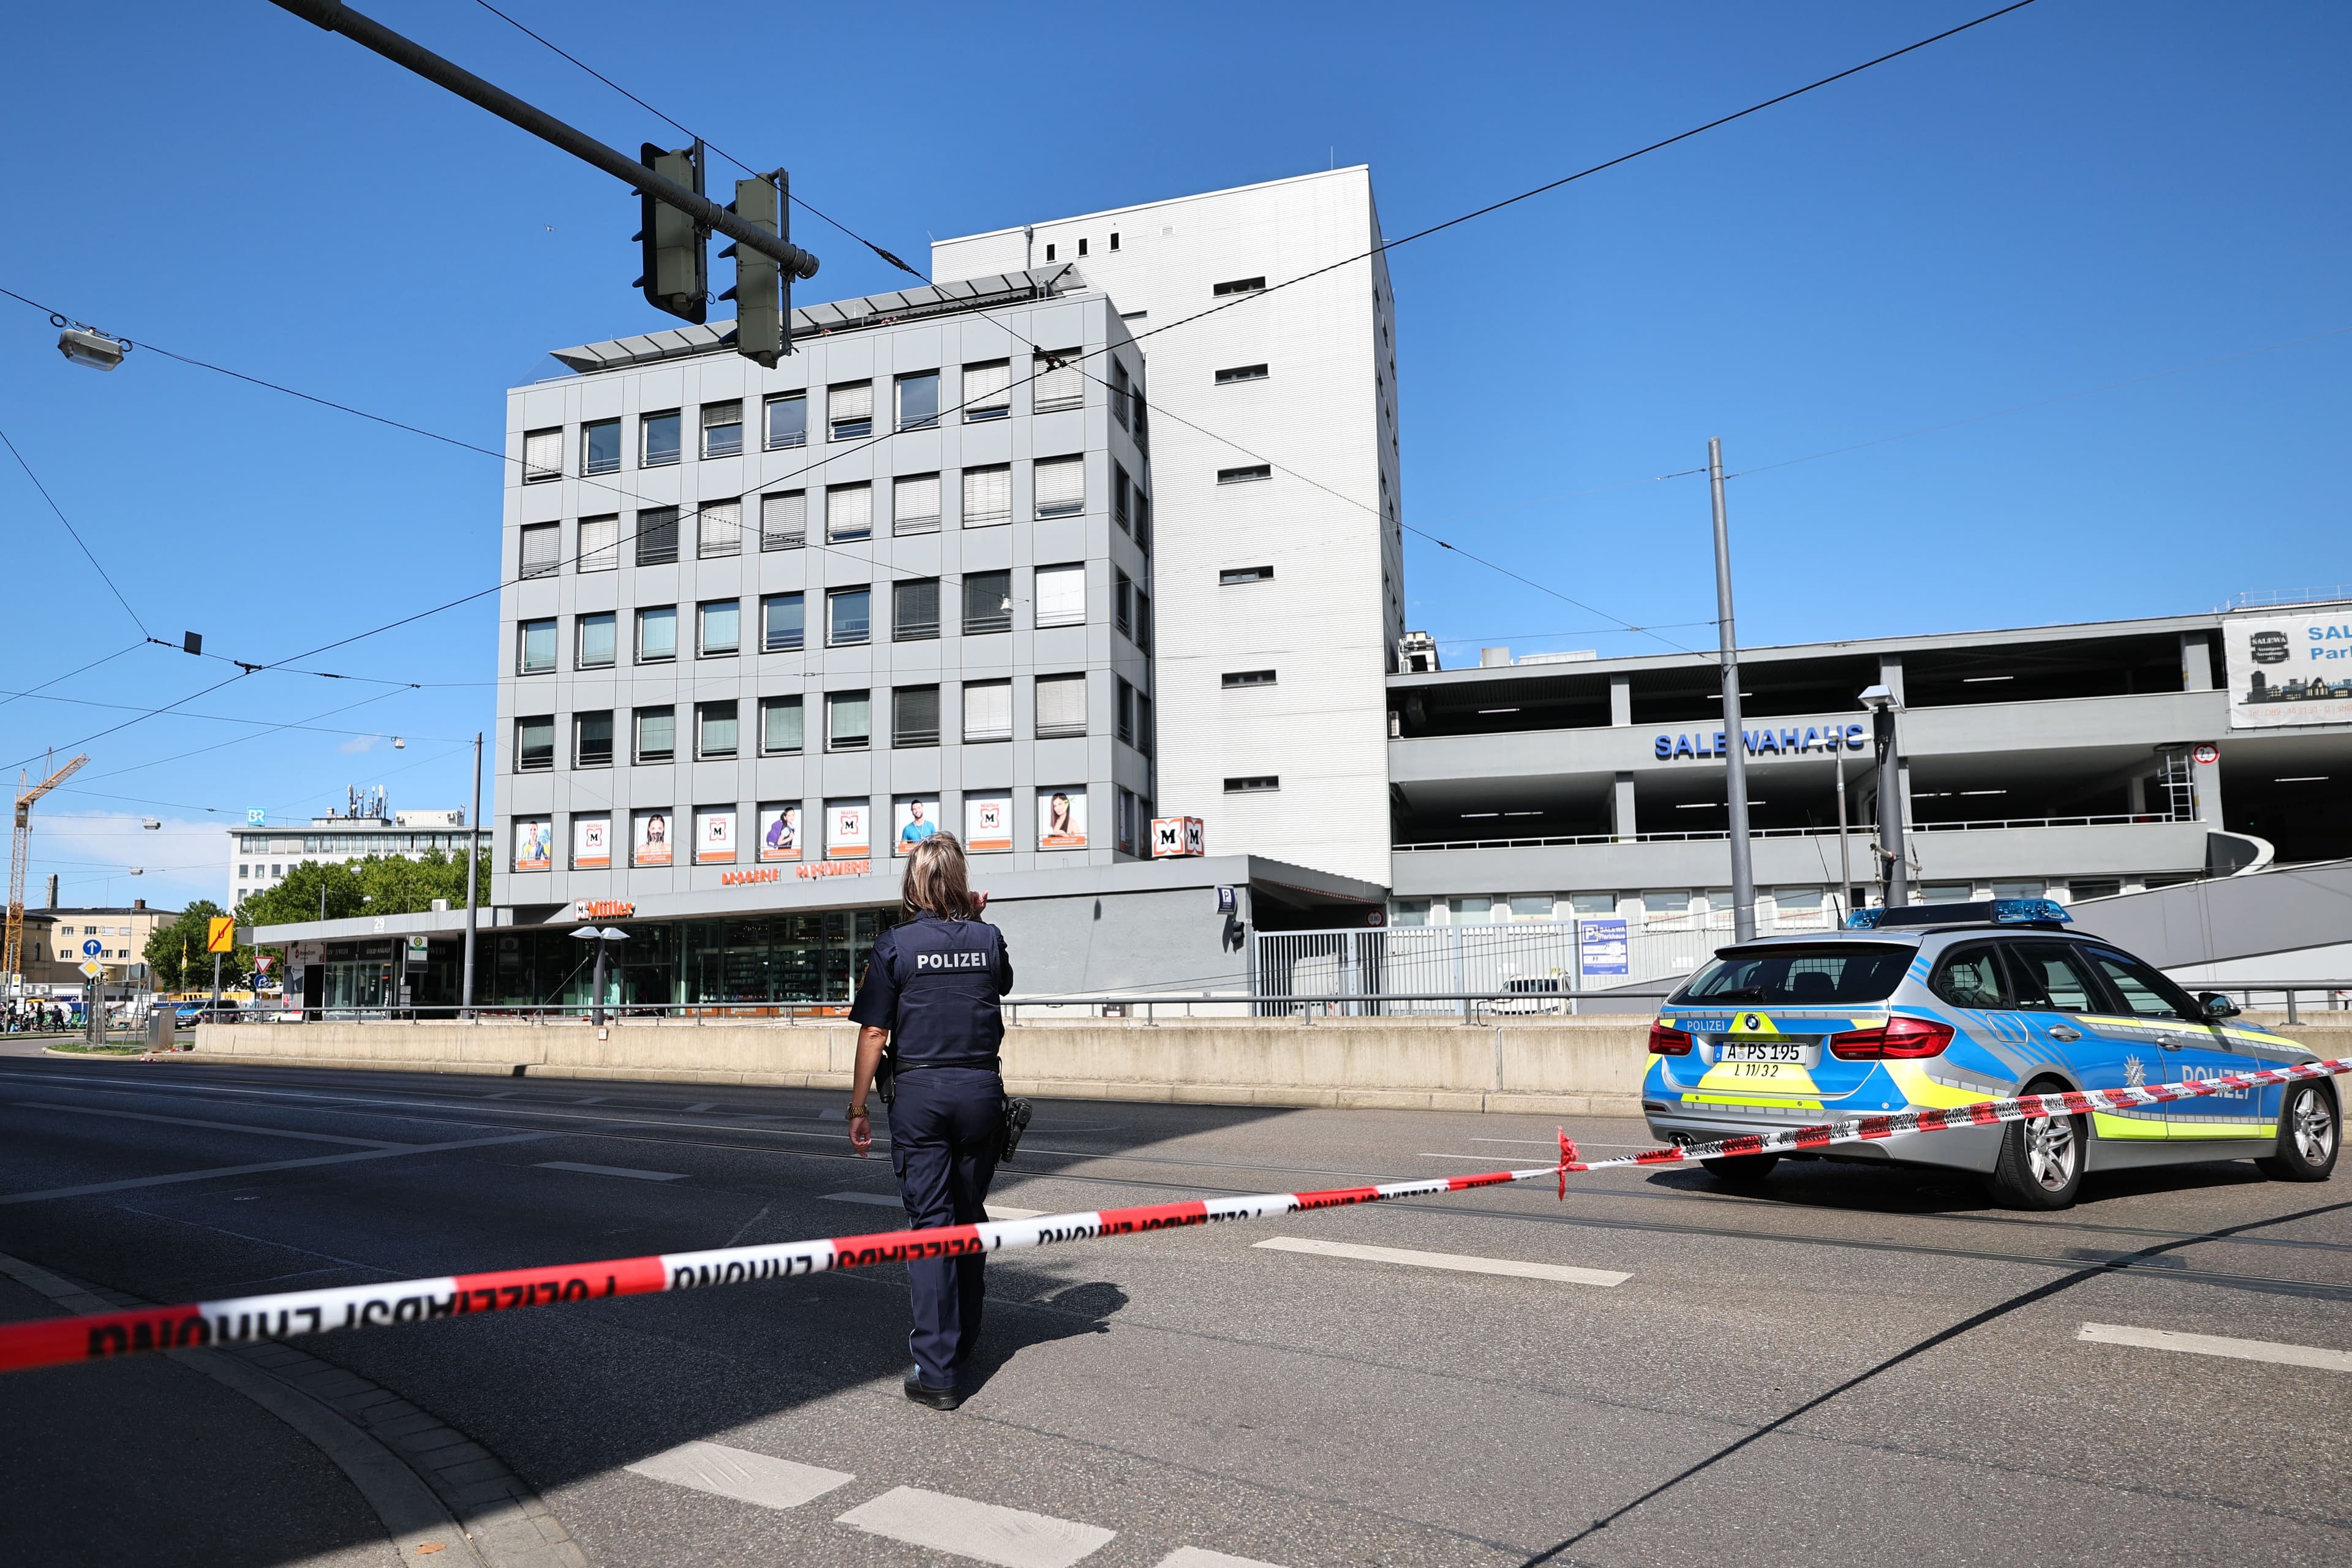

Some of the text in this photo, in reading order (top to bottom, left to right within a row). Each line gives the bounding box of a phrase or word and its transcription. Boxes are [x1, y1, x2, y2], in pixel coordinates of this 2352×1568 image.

[2251, 636, 2286, 645] SALEWA
[1655, 724, 1864, 757] SALEWAHAUS
[248, 809, 265, 822] BR
[985, 814, 995, 823] M
[590, 833, 598, 842] M
[1160, 829, 1176, 845] M
[1189, 829, 1199, 845] M
[722, 869, 779, 885] DROGERIE
[1224, 891, 1229, 900] P
[588, 900, 633, 917] Müller
[374, 918, 385, 929] 29
[1585, 927, 1595, 940] P
[917, 952, 987, 969] POLIZEI
[1687, 1020, 1725, 1031] POLIZEI
[1727, 1043, 1801, 1060] A PS 195
[1735, 1063, 1740, 1076] L
